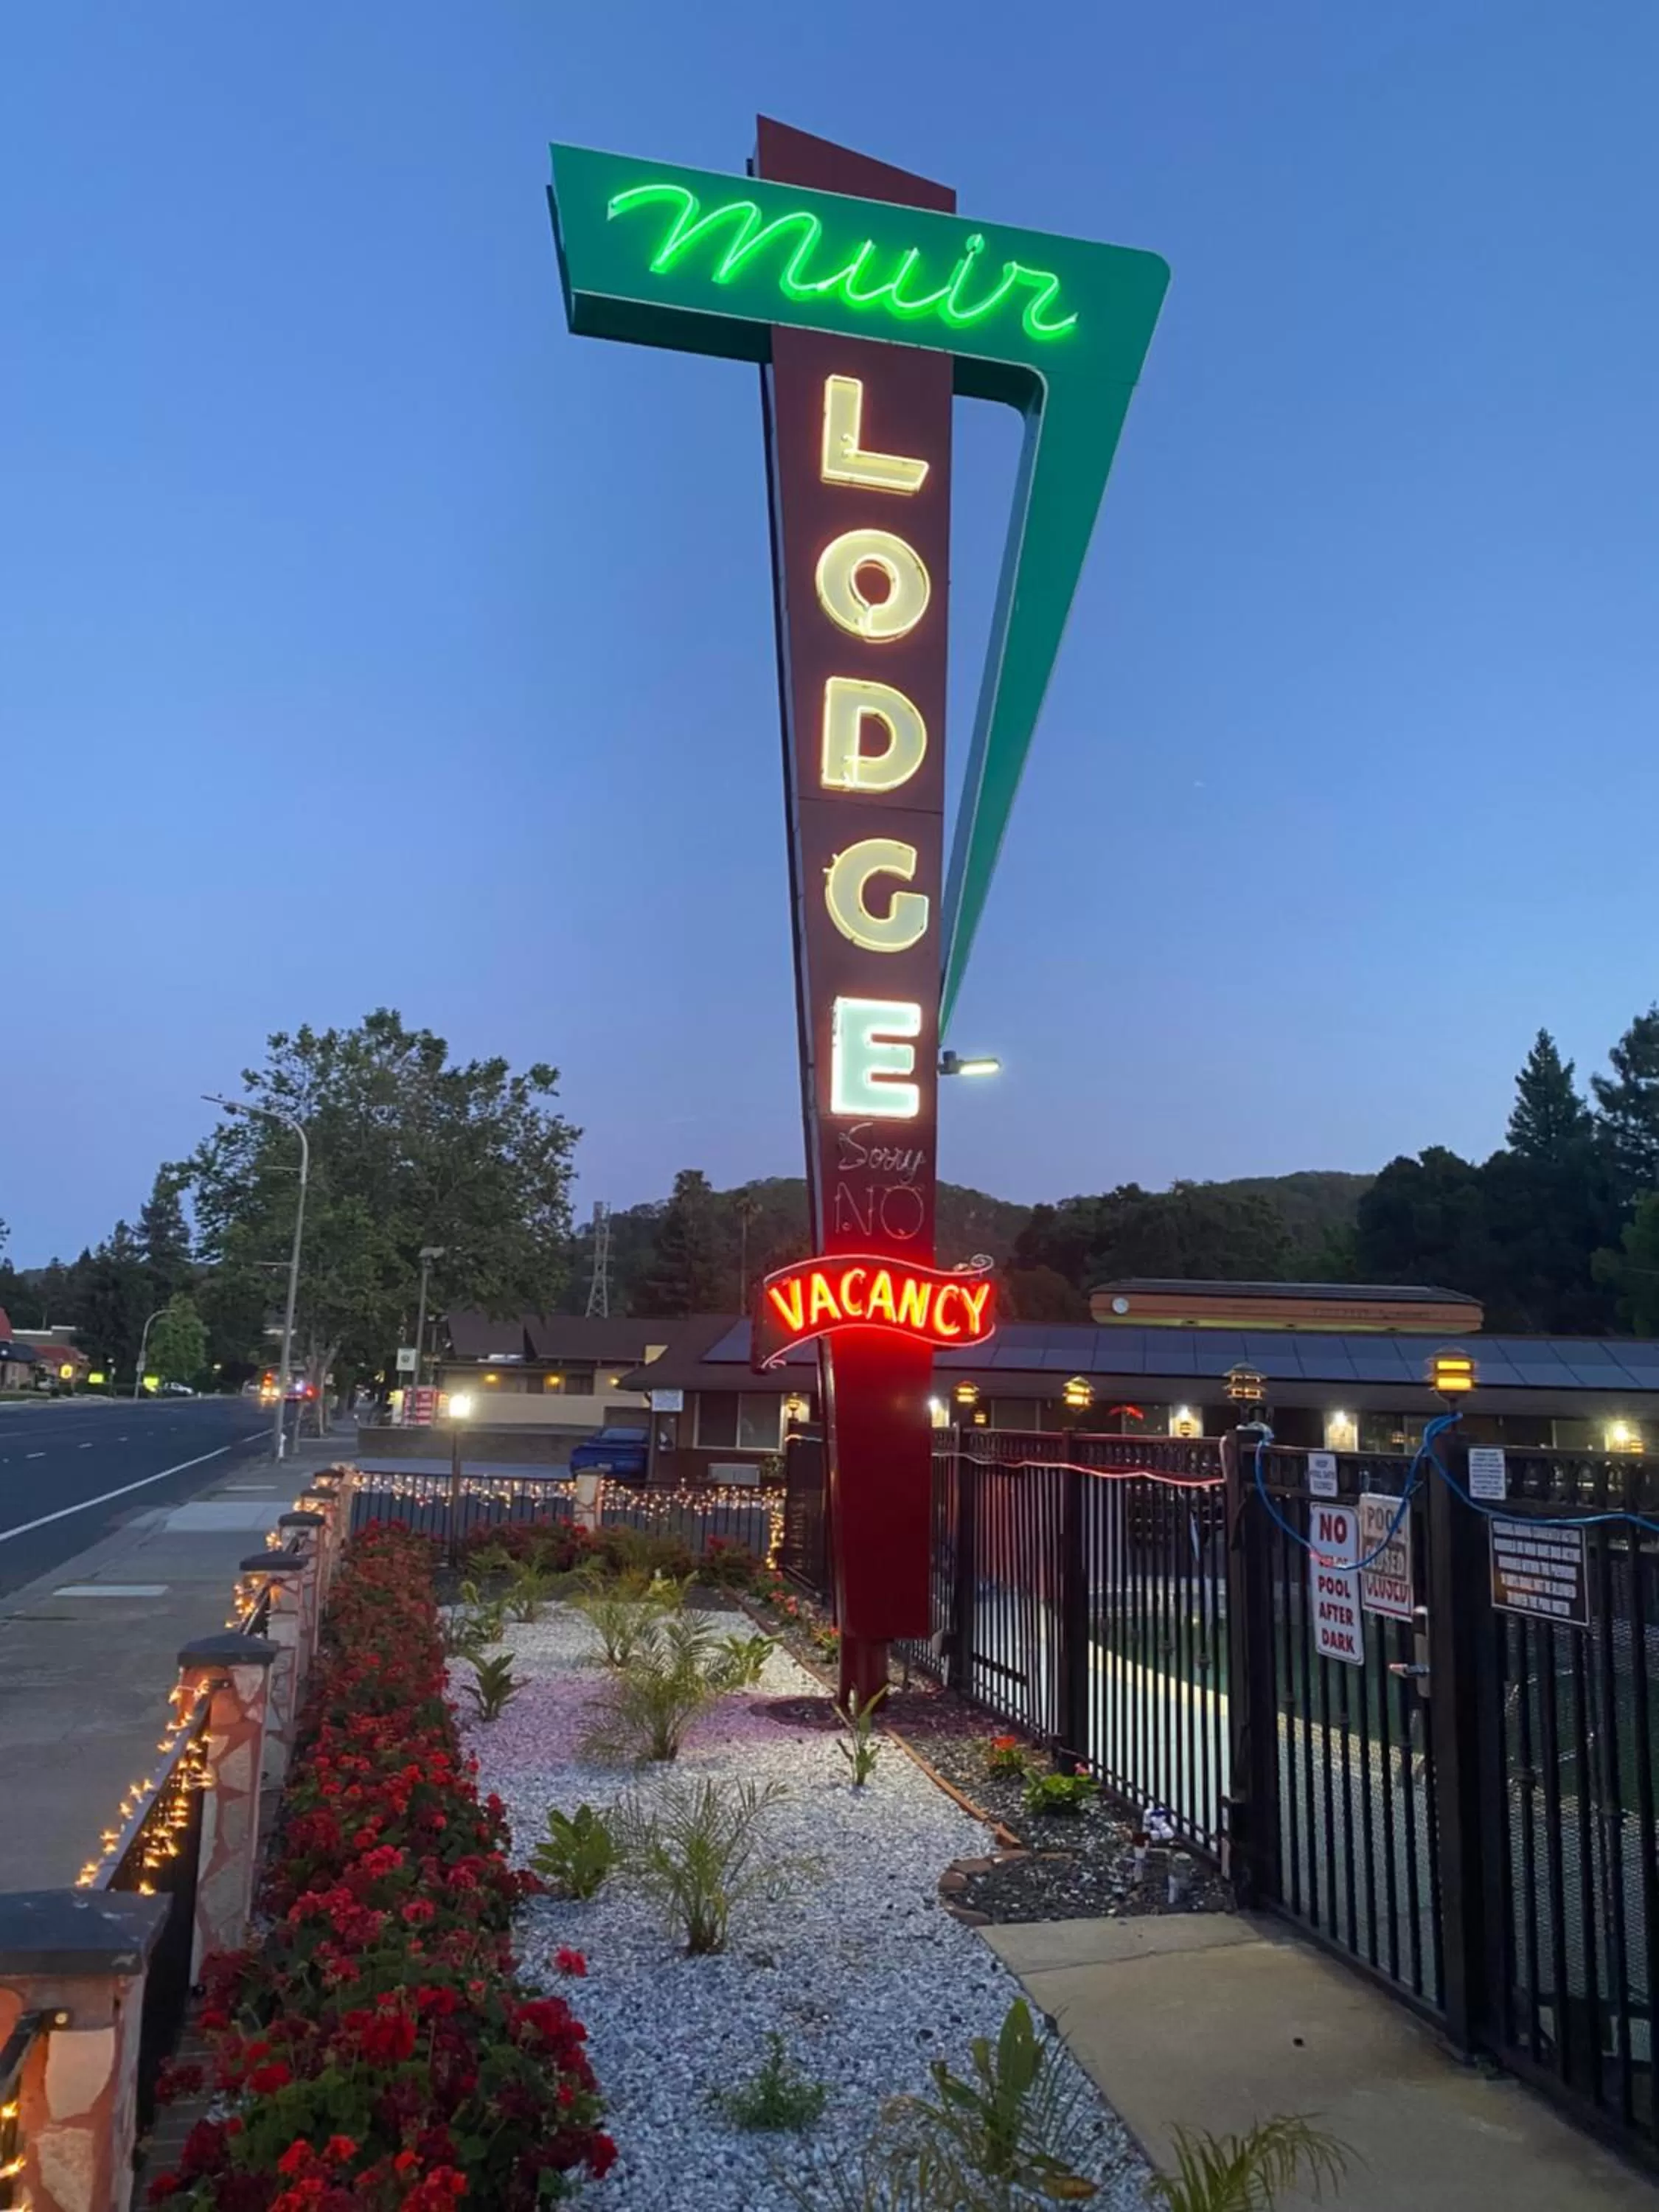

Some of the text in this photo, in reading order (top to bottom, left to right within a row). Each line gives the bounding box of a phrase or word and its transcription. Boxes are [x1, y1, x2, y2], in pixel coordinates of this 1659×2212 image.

[815, 374, 931, 1119] LODGE
[838, 1121, 926, 1184] Sorry
[835, 1182, 925, 1239] NO
[768, 1268, 990, 1335] VACANCY
[1319, 1512, 1347, 1544] NO
[1318, 1575, 1351, 1599] POOL
[1319, 1601, 1354, 1627] AFTER
[1321, 1627, 1355, 1654] DARK
